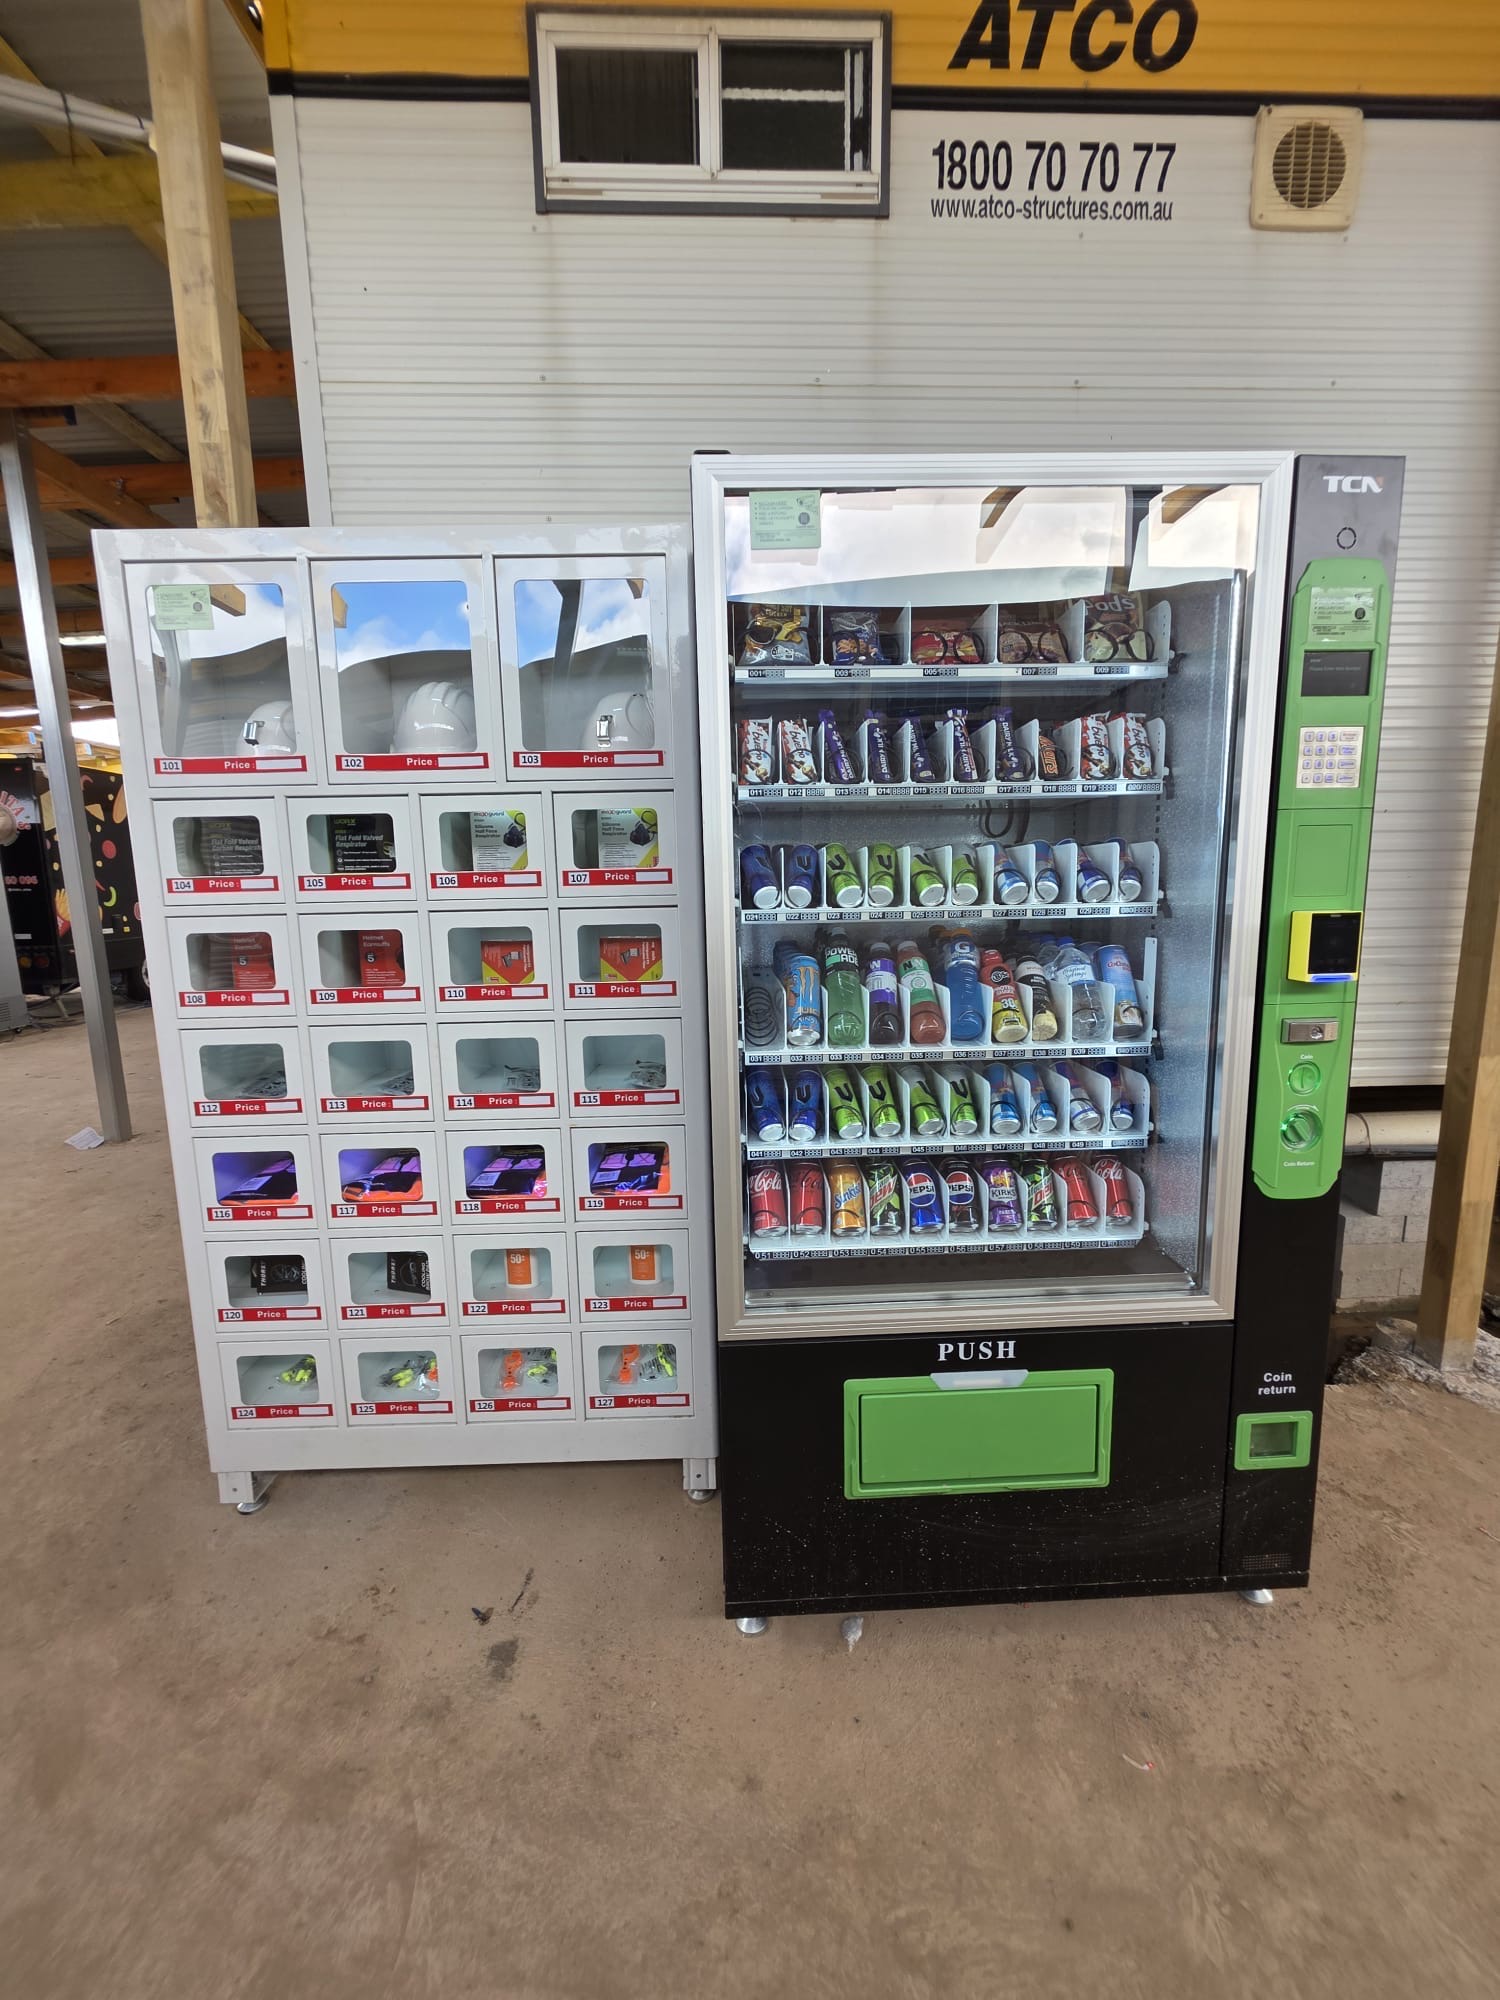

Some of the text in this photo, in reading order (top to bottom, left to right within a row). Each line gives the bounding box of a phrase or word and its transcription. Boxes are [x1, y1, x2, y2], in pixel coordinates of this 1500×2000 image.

[948, 0, 1198, 72] ATCO
[931, 139, 1178, 193] 1800 70 70 77
[930, 195, 1174, 222] www.atco-structures.com.au
[1323, 475, 1383, 493] TCN
[344, 759, 363, 768] 102
[521, 755, 540, 764] 103
[162, 761, 180, 770] 101
[998, 786, 1012, 794] 017
[439, 876, 457, 886] 106
[570, 874, 588, 883] 107
[174, 881, 192, 890] 104
[306, 879, 324, 887] 105
[447, 990, 464, 998] 110
[577, 987, 594, 995] 111
[186, 995, 204, 1004] 108
[318, 993, 336, 1001] 109
[456, 1099, 474, 1107] 114
[581, 1095, 599, 1104] 115
[201, 1105, 218, 1113] 112
[328, 1101, 346, 1109] 113
[991, 1188, 1016, 1198] KIRKS
[463, 1203, 480, 1211] 118
[587, 1200, 604, 1208] 119
[214, 1210, 231, 1218] 116
[338, 1207, 356, 1215] 117
[470, 1305, 487, 1313] 122
[592, 1301, 609, 1309] 123
[224, 1311, 242, 1319] 120
[348, 1309, 366, 1317] 121
[937, 1340, 1017, 1361] PUSH
[1263, 1372, 1292, 1382] Coin
[1258, 1385, 1296, 1395] return
[476, 1402, 494, 1410] 126
[597, 1399, 614, 1407] 127
[358, 1405, 375, 1413] 125
[238, 1409, 254, 1418] 124
